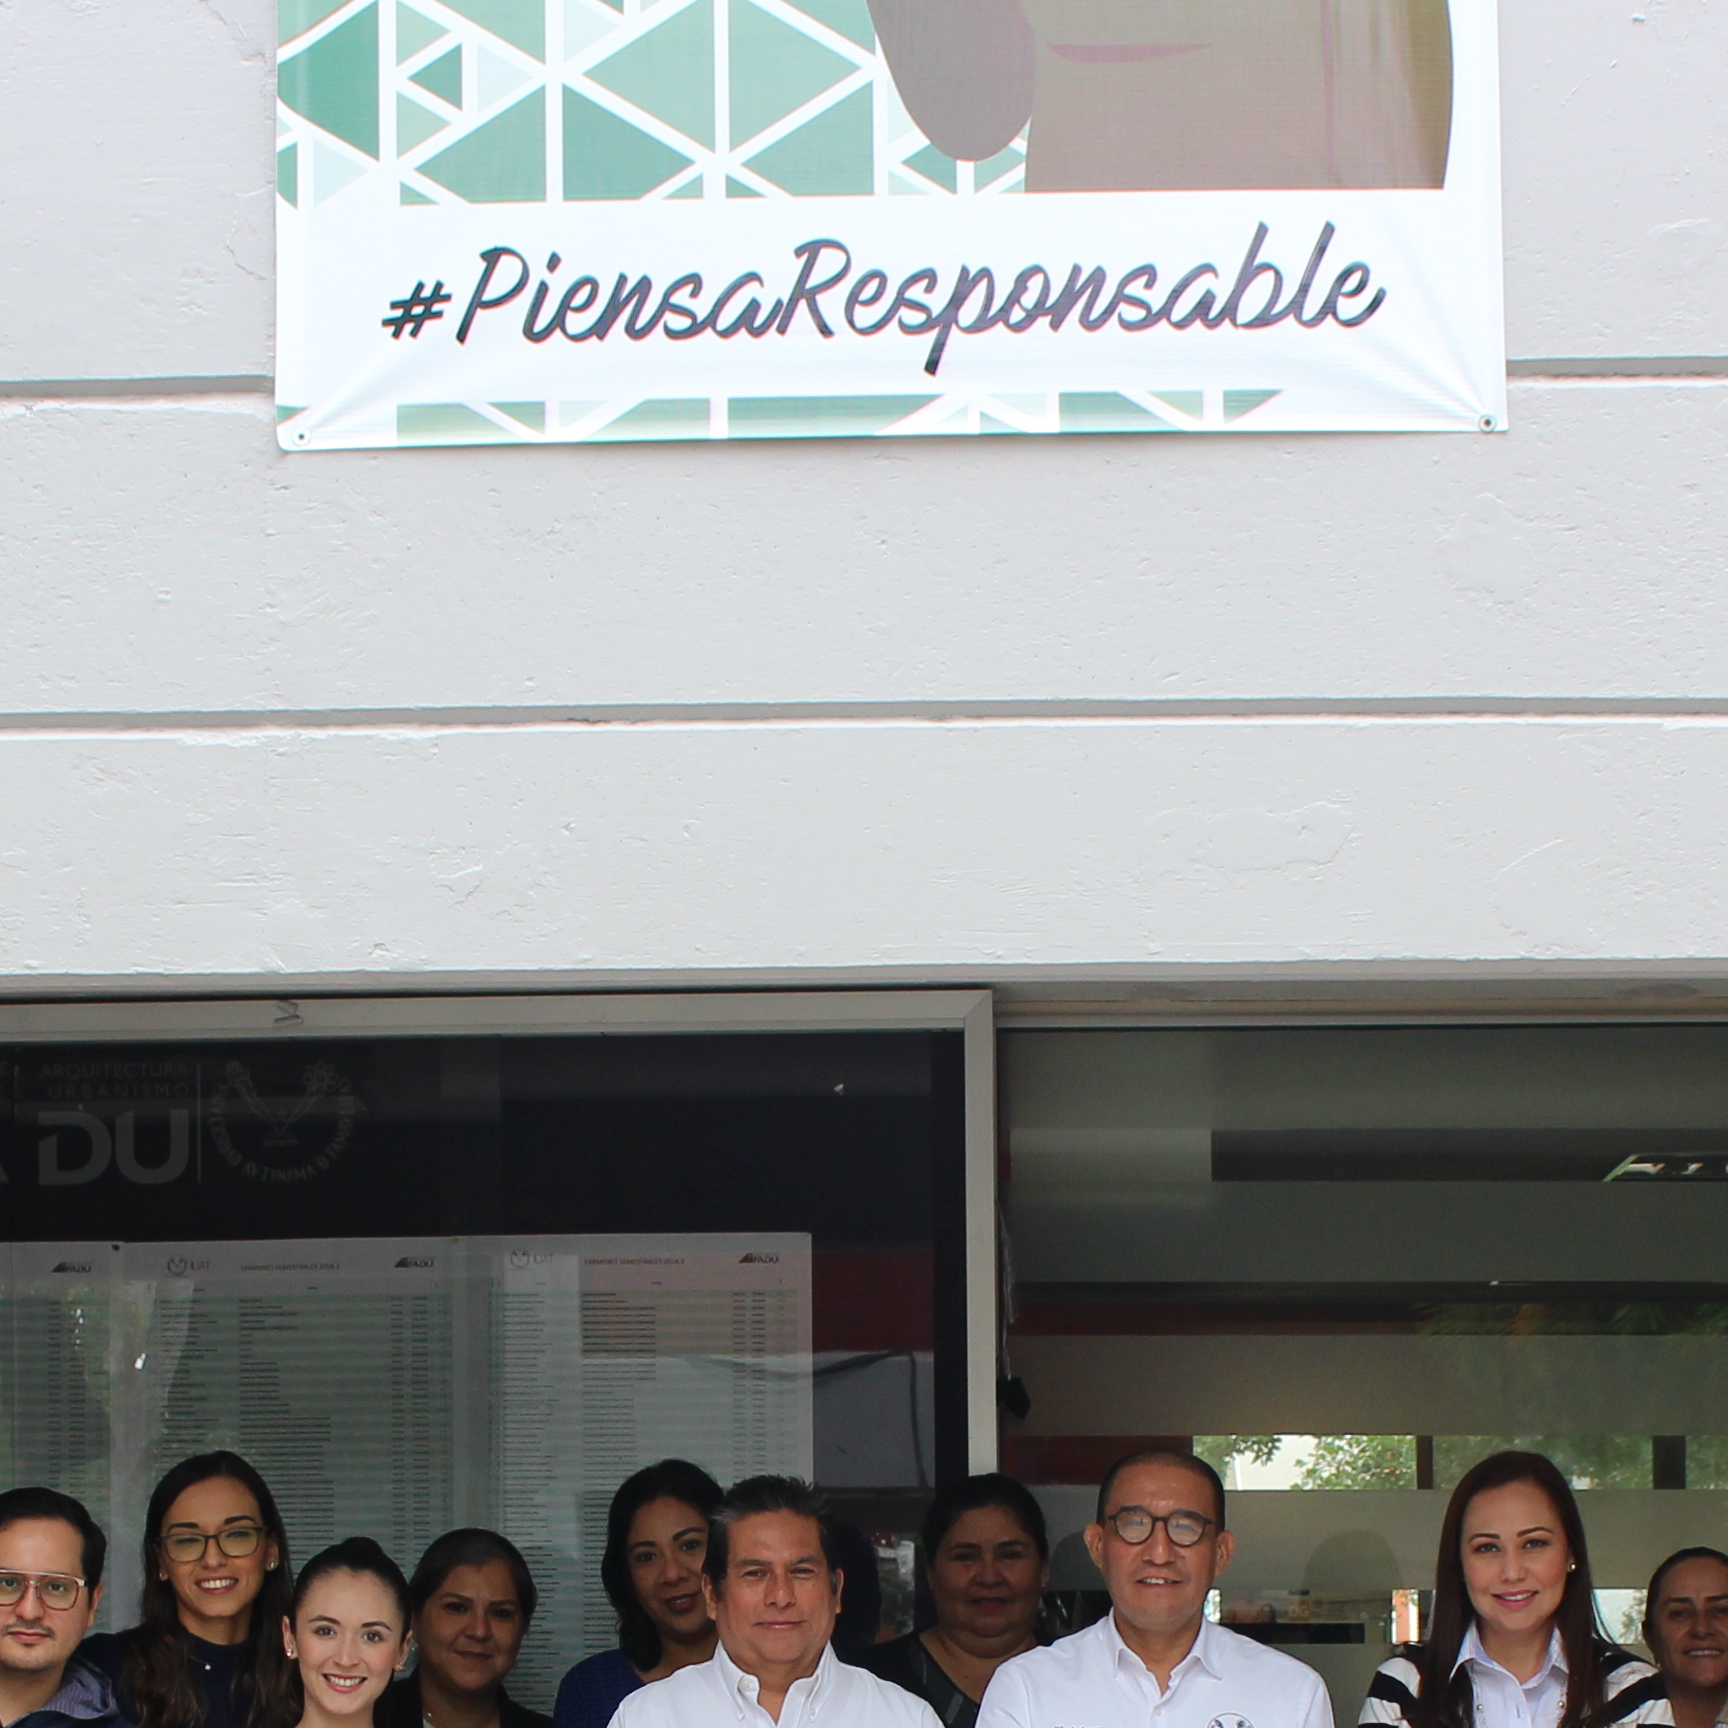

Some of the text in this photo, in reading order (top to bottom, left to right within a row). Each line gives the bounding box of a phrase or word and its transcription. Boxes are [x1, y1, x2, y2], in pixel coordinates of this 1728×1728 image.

[381, 220, 1388, 378] #PiensaResponsable
[40, 1062, 188, 1080] ARQUITECTURA
[48, 1083, 189, 1099] URBANISMO
